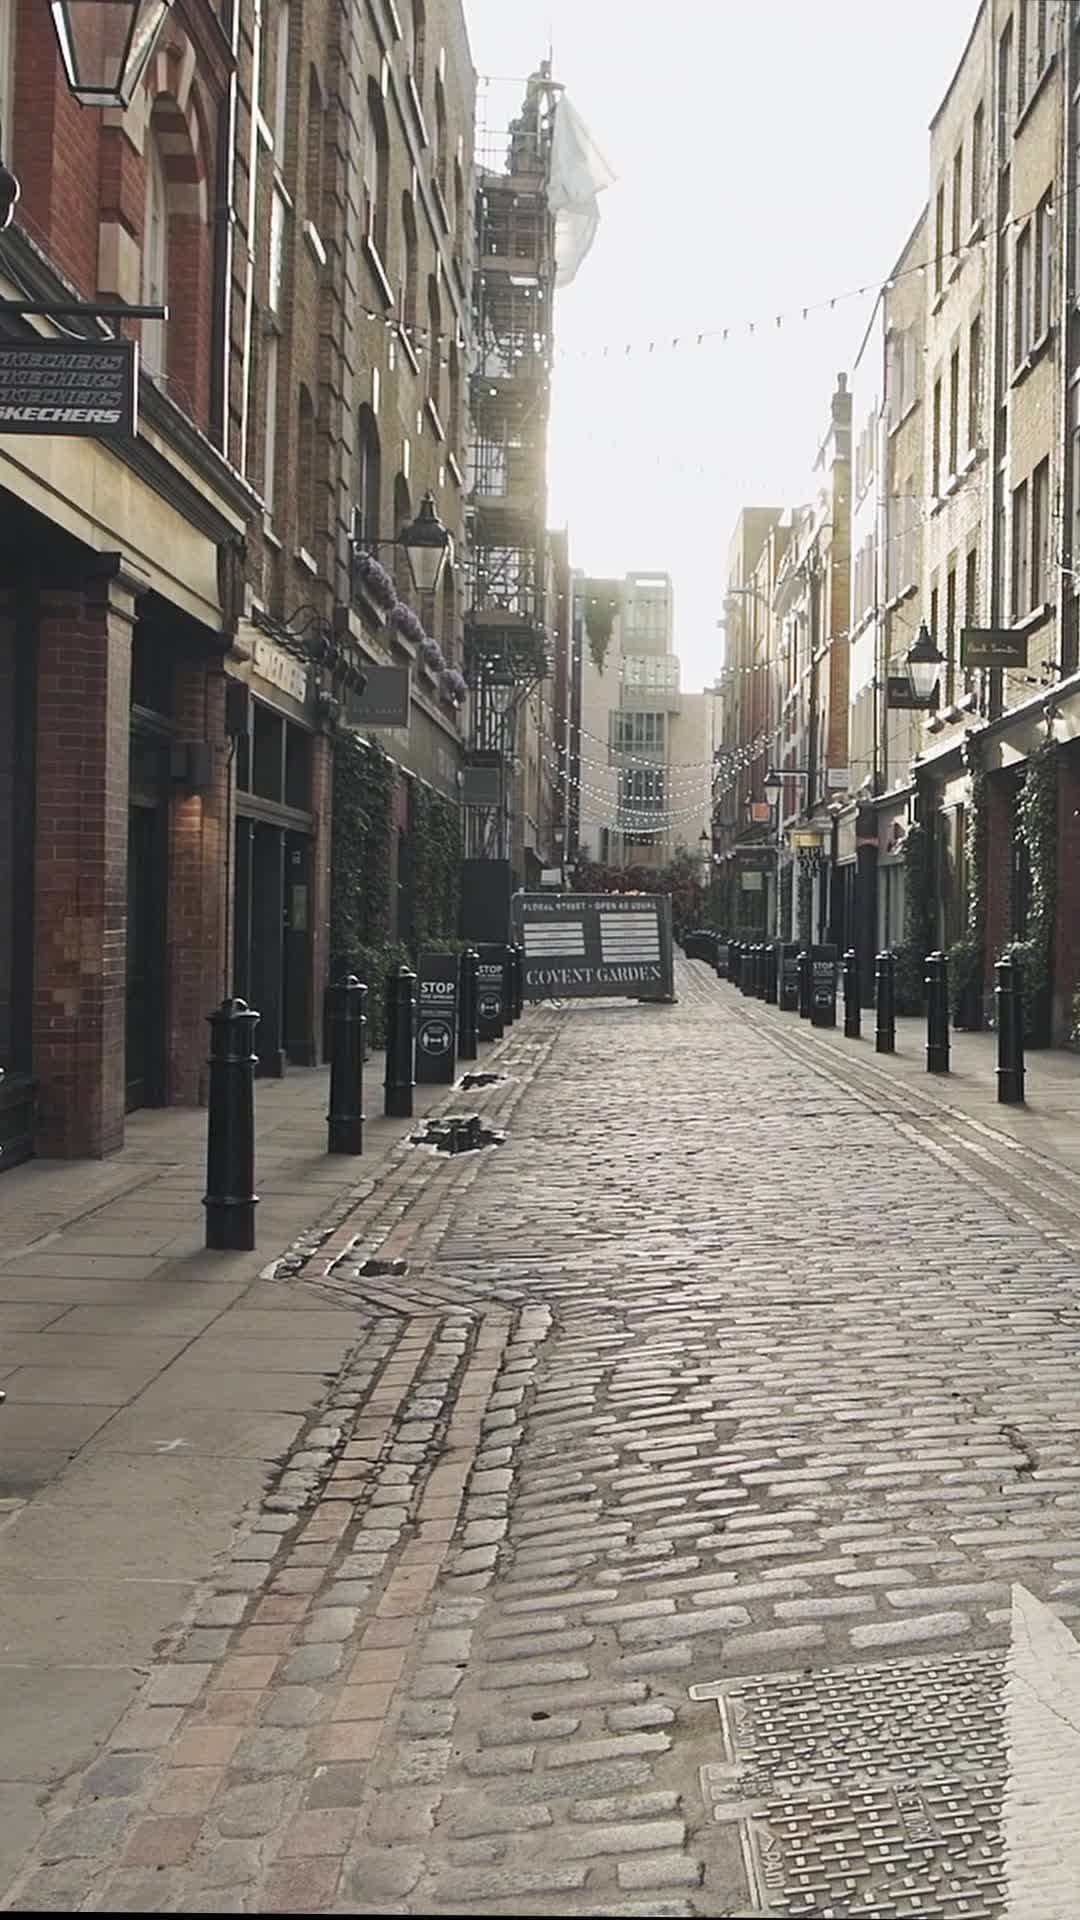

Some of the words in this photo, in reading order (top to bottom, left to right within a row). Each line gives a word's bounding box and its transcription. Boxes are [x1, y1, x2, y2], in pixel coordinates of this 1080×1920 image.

[478, 965, 503, 974] STOP
[812, 961, 834, 969] STOP
[526, 967, 594, 985] COVENT
[597, 966, 662, 983] GARDEN
[420, 981, 455, 994] STOP
